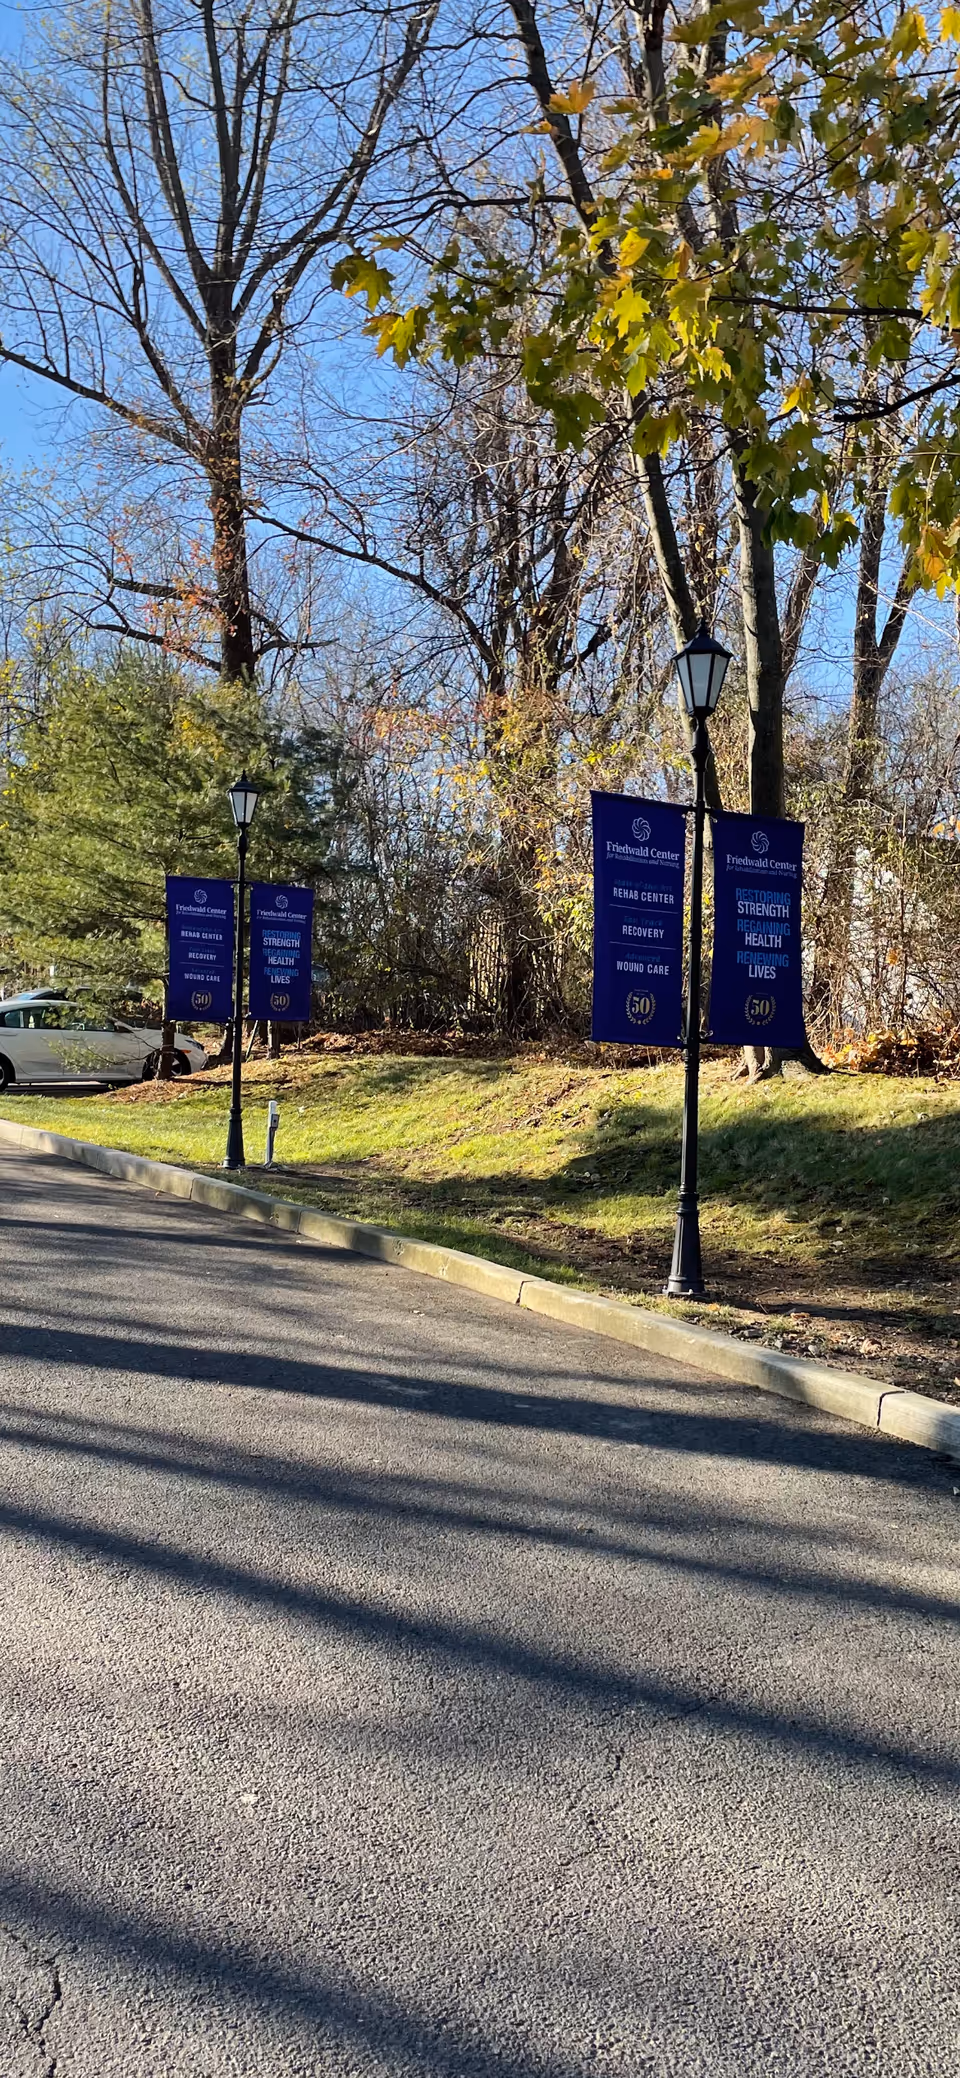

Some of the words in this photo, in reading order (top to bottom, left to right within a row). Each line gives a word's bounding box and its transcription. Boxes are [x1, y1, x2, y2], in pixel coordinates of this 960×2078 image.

[606, 841, 649, 857] Friedwald
[651, 848, 680, 861] Center
[726, 854, 768, 868] Friedwald
[770, 860, 798, 872] Center
[613, 887, 639, 900] REHAB
[641, 891, 675, 905] CENTER
[736, 888, 791, 906] RESTORING
[207, 907, 227, 915] Center
[738, 901, 790, 918] STRENGTH
[622, 925, 665, 939] RECOVERY
[737, 919, 791, 936] REGAINING
[181, 931, 200, 939] REHAB
[202, 933, 223, 941] CENTER
[263, 938, 300, 948] STRENGTH
[745, 933, 782, 949] HEALTH
[189, 952, 217, 961] RECOVERY
[268, 957, 295, 966] HEALTH
[737, 951, 789, 967] RENEWING
[617, 961, 644, 973] WOUND
[647, 964, 670, 975] CARE
[749, 964, 777, 980] LIVES
[184, 973, 205, 981] WOUND
[206, 975, 221, 983] CARE
[271, 976, 291, 984] LIVES
[195, 994, 209, 1005] 50
[274, 996, 287, 1006] 50
[632, 996, 650, 1015] 50
[751, 999, 770, 1016] 50
